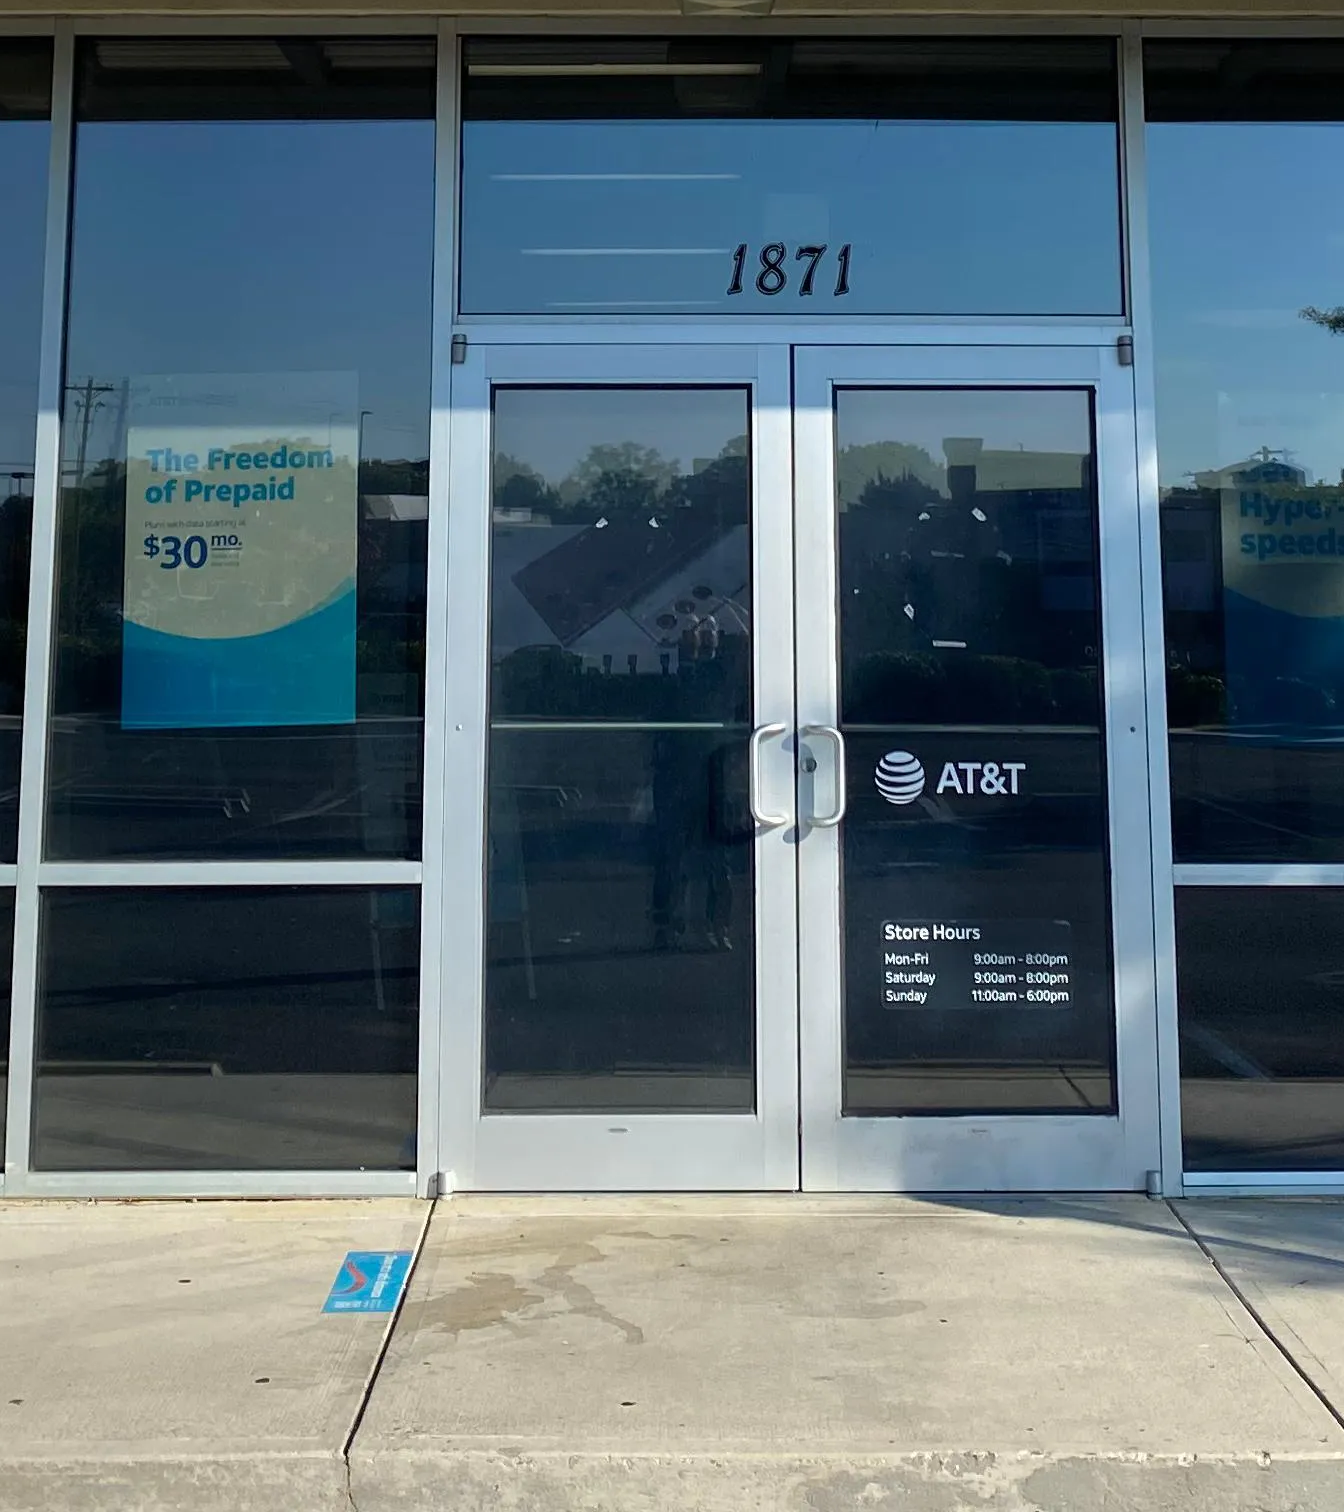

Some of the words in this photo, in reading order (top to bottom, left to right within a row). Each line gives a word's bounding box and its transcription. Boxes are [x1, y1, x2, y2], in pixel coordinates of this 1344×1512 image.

[727, 242, 852, 296] 1871
[146, 448, 199, 472] The
[207, 445, 333, 471] Freedom
[145, 479, 177, 504] of
[184, 476, 295, 508] Prepaid
[144, 533, 208, 569] $30
[211, 534, 242, 546] mo.
[936, 762, 1026, 795] AT&T
[885, 924, 930, 941] Store
[933, 924, 981, 940] Hours
[885, 952, 929, 966] Mon-Fri
[973, 953, 1016, 965] 9:00am
[1025, 953, 1068, 967] 8:00pm
[885, 971, 936, 986] Saturday
[974, 972, 1016, 984] 9:00am
[1026, 972, 1069, 986] 8:00pm
[885, 990, 928, 1004] Sunday
[971, 990, 1017, 1002] 11:00am
[1026, 990, 1069, 1004] 6:00pm
